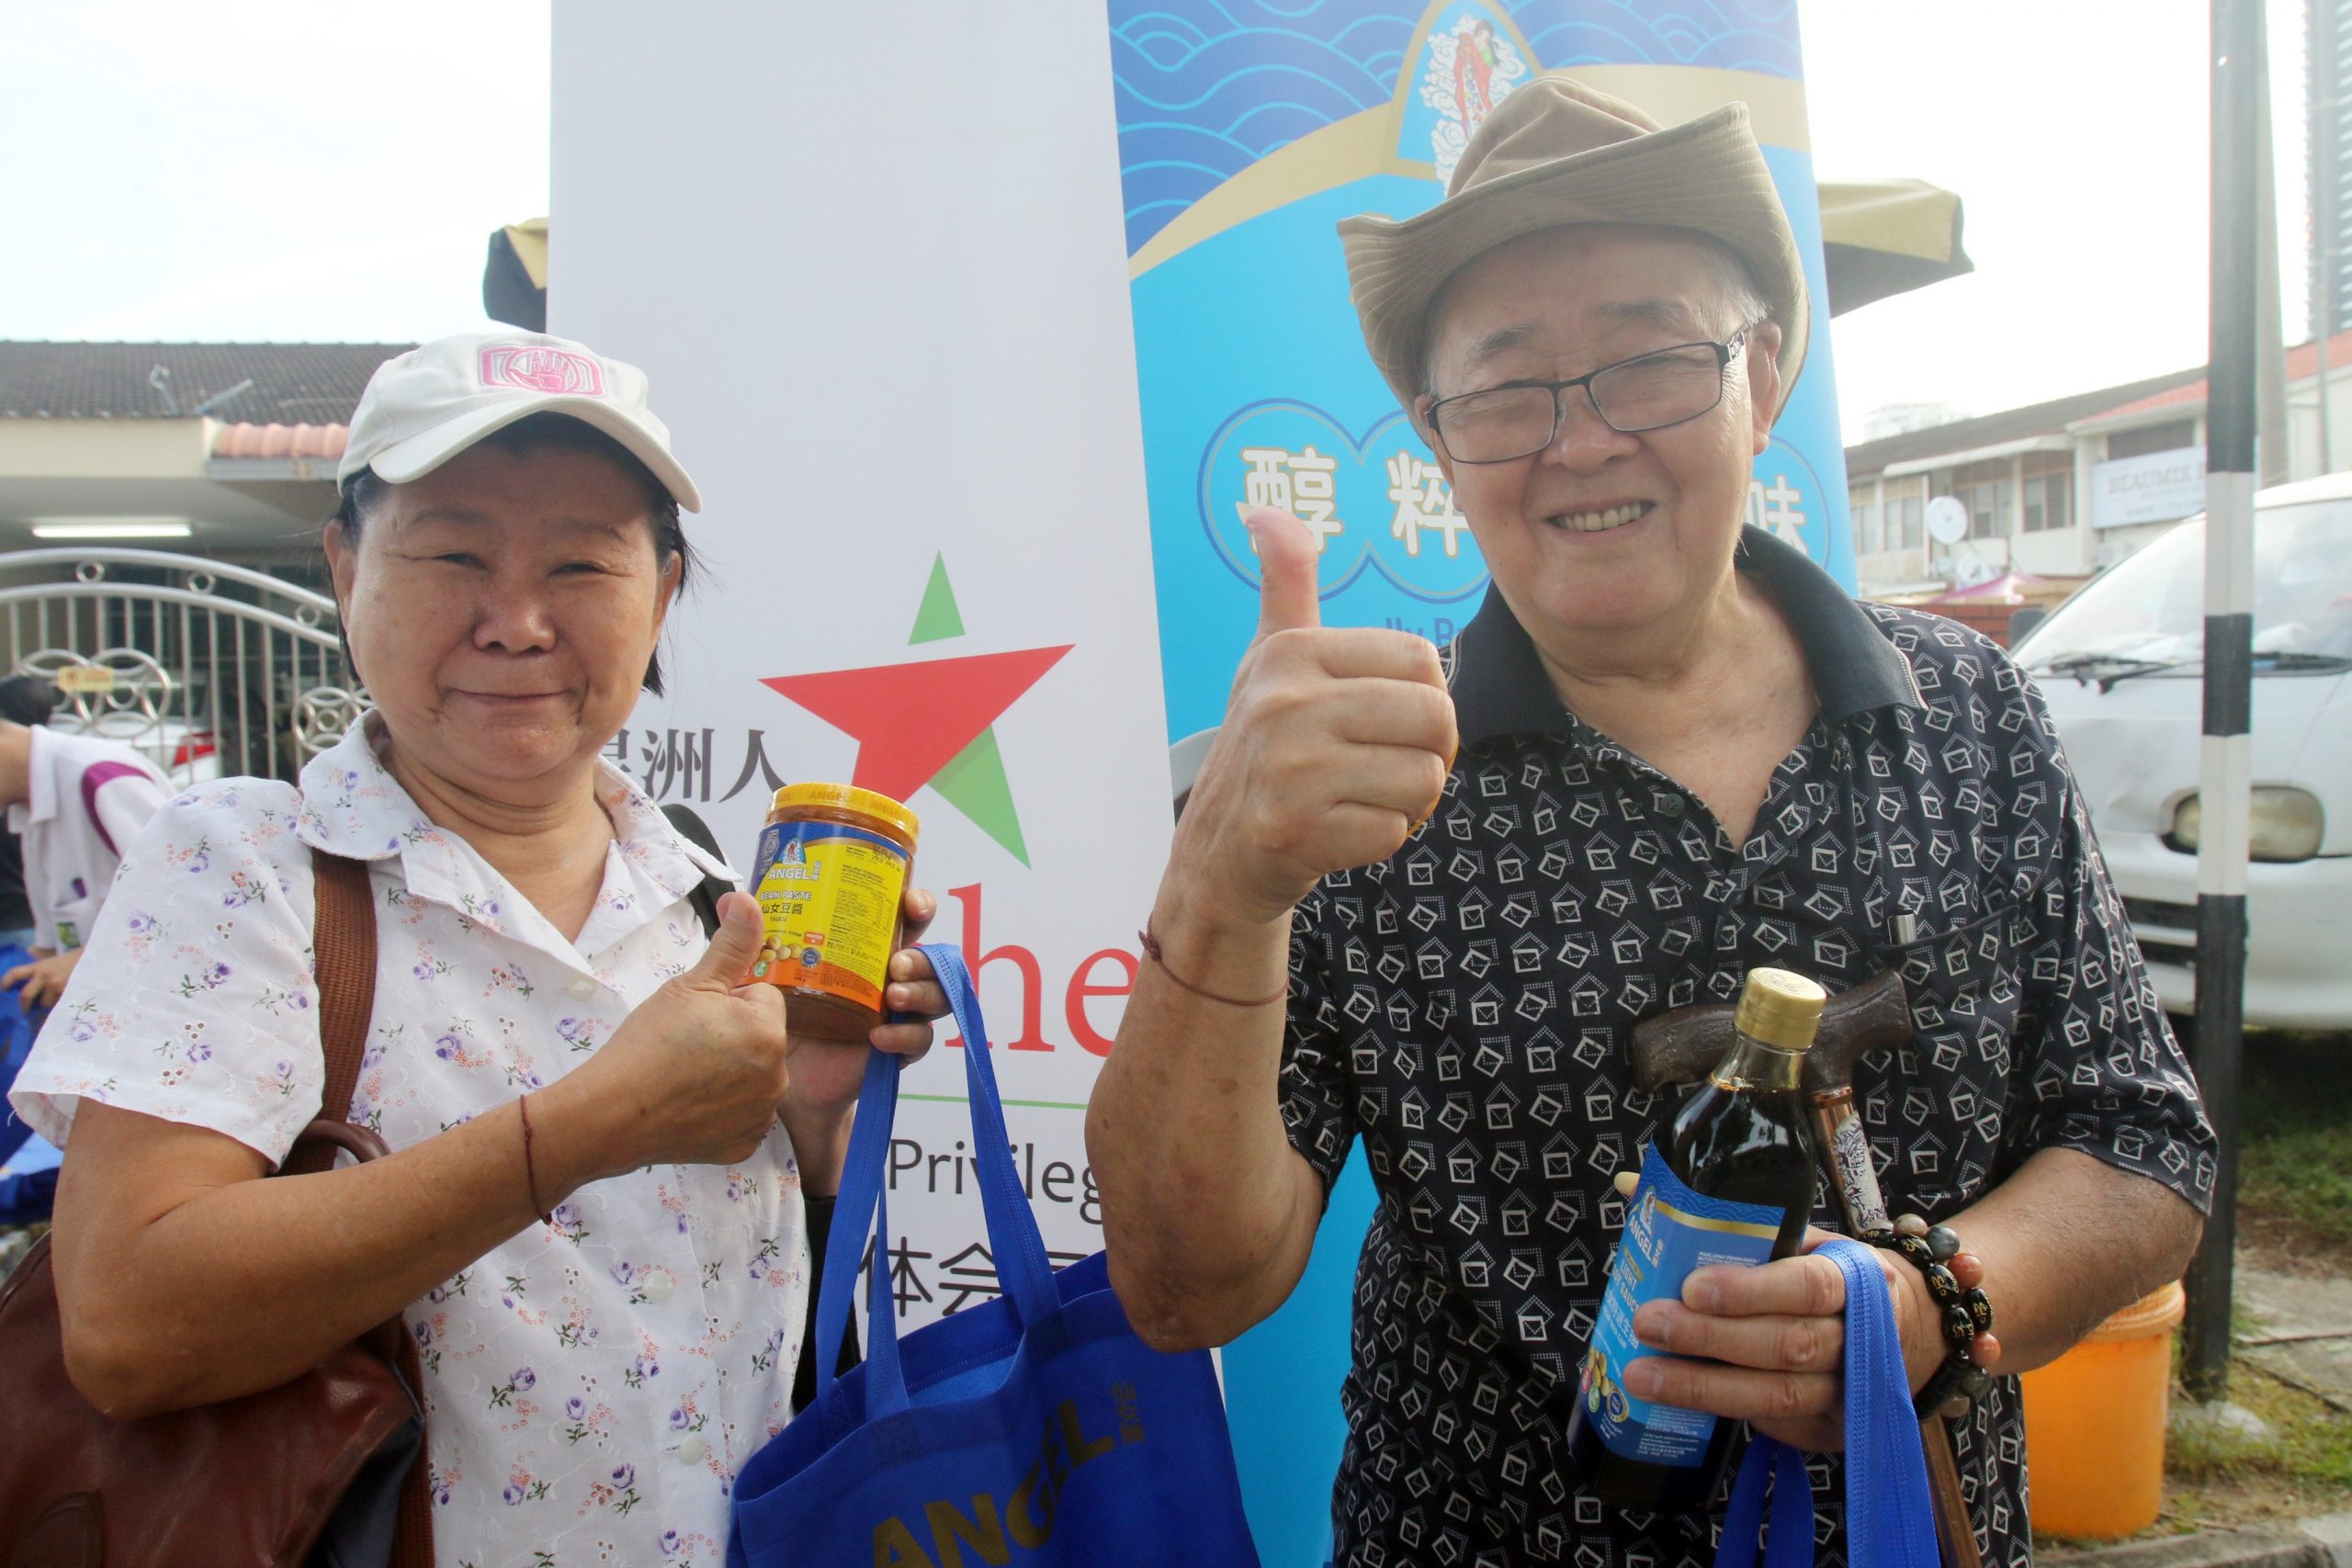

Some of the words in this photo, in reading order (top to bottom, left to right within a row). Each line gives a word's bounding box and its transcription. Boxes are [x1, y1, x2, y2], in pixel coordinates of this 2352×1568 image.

[760, 891, 780, 900] BEAN
[781, 890, 812, 901] PASTE
[769, 867, 810, 881] ANGEL
[913, 882, 1141, 1058] he
[888, 1139, 1102, 1225] Prileg
[1628, 1214, 1652, 1262] ANGEL
[1620, 1259, 1637, 1291] LIGHT
[873, 1398, 1114, 1568] ANGEL
